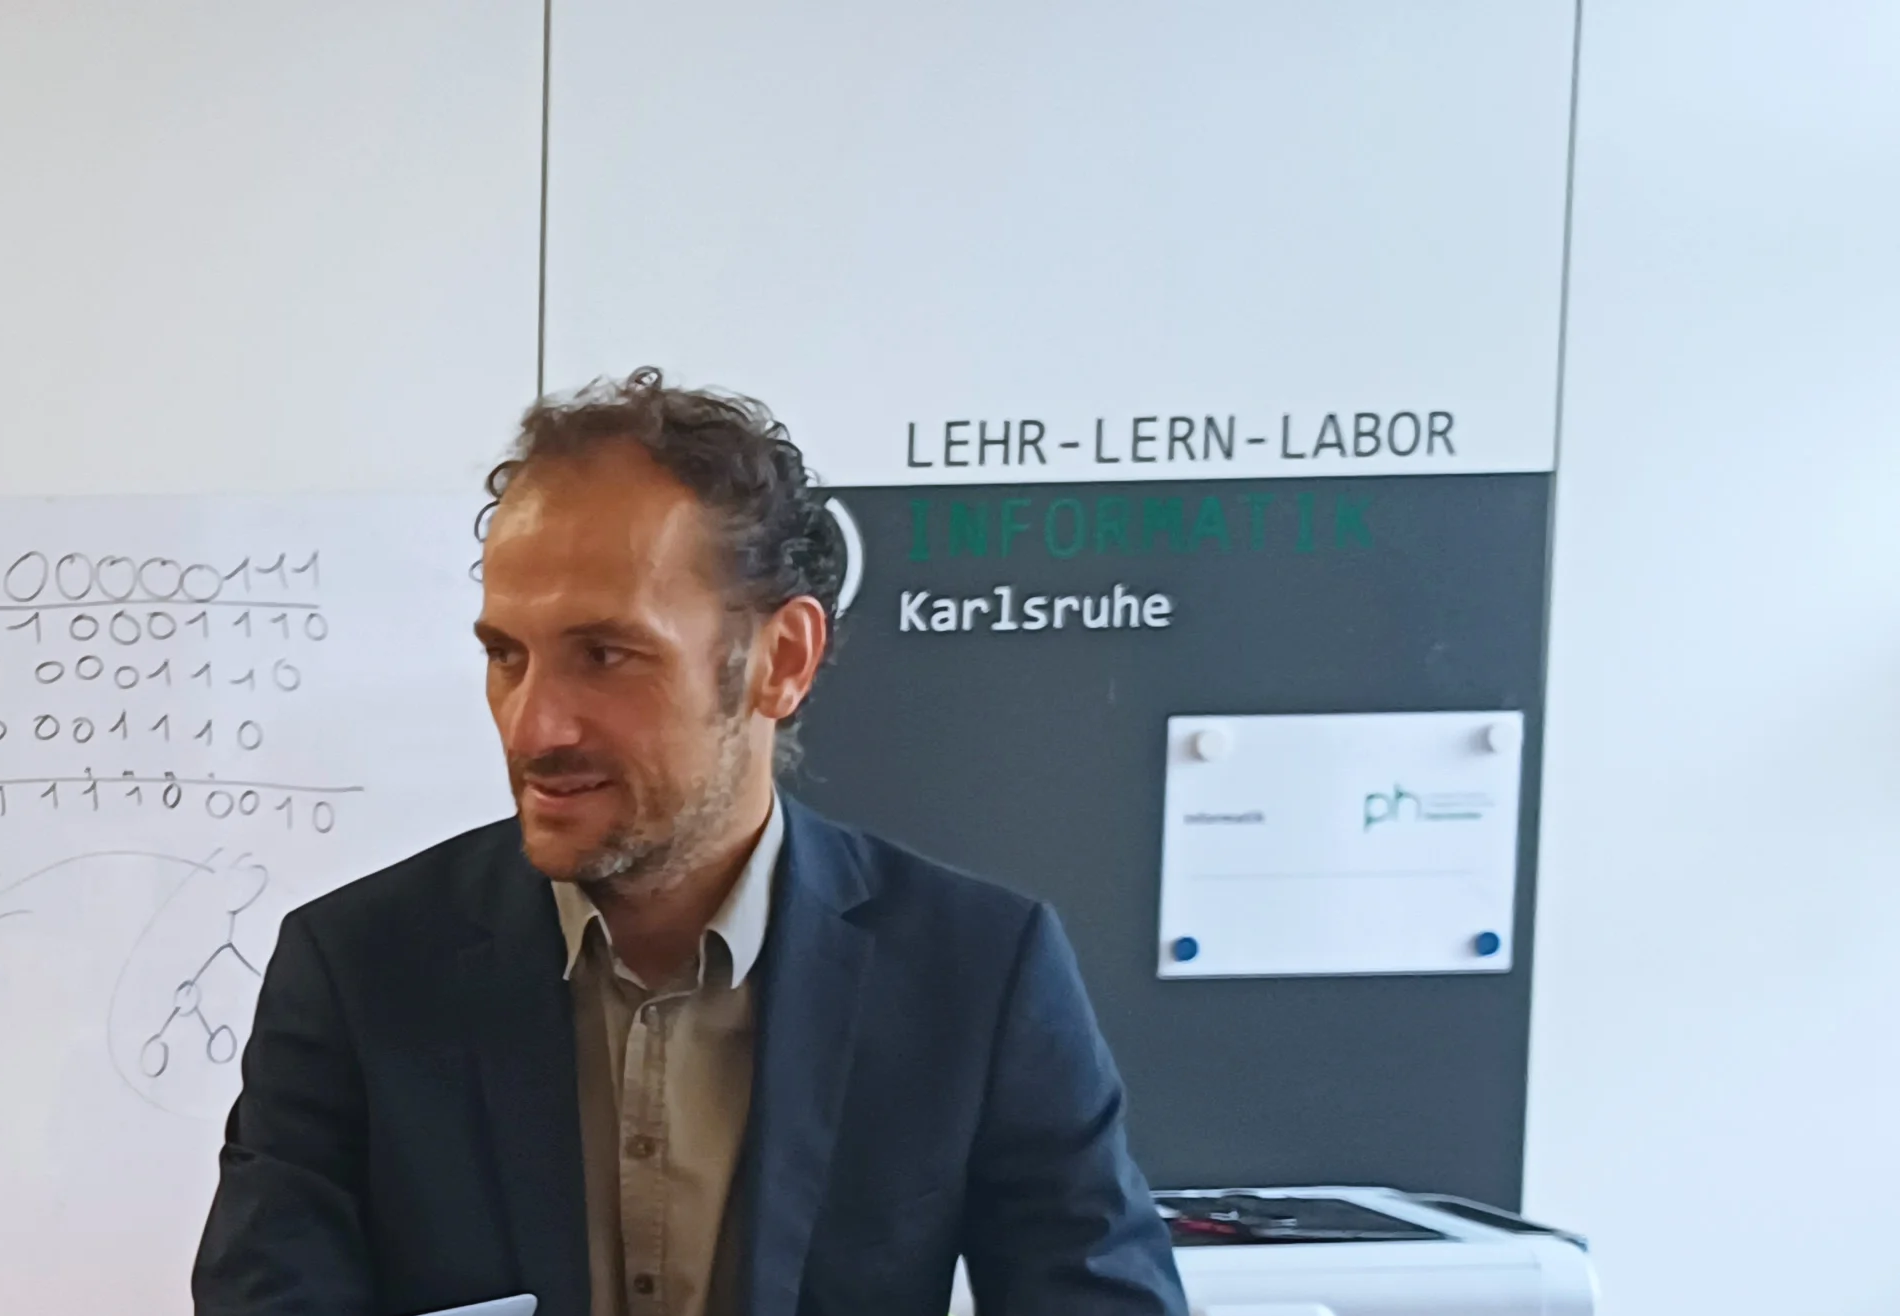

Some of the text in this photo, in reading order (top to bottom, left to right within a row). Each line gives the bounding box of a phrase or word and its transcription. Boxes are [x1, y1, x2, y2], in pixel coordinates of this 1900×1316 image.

[905, 410, 1458, 468] LEHR-LERN-LABOR
[908, 491, 1377, 562] INFORMATIK
[899, 583, 1174, 633] Karlsruhe
